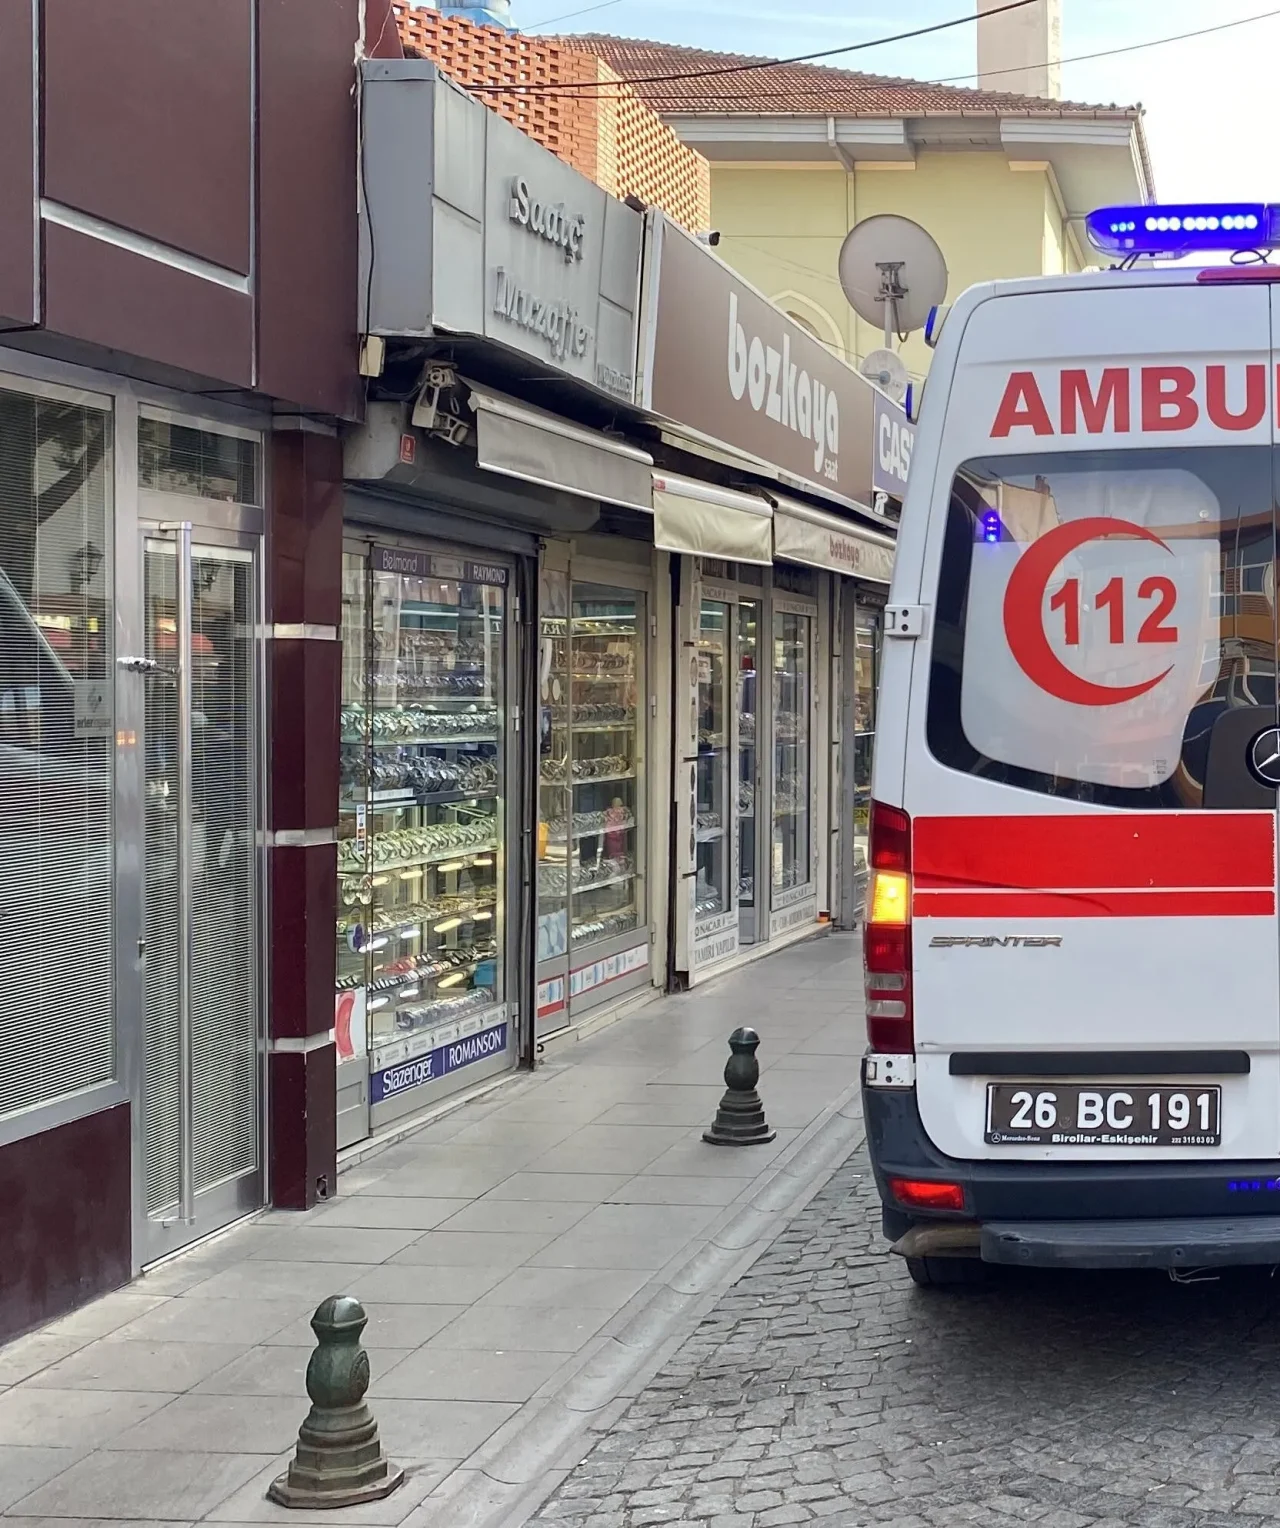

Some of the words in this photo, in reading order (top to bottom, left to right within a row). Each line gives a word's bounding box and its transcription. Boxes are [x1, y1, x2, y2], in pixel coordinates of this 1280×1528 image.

[509, 175, 585, 264] Saatçi
[728, 291, 839, 473] bozkaya
[824, 457, 839, 482] saat
[382, 550, 418, 573] Belmond
[473, 564, 506, 584] RAYMOND
[829, 534, 860, 571] bozkaya
[1050, 576, 1178, 646] 112
[929, 936, 1063, 948] SPRINTER
[383, 1058, 433, 1094] Slazenger
[449, 1029, 502, 1068] ROMANSON
[1010, 1091, 1057, 1129] 26
[1077, 1092, 1134, 1130] BC
[1148, 1092, 1210, 1130] 191
[1052, 1133, 1158, 1145] Birollar-Eskişehir
